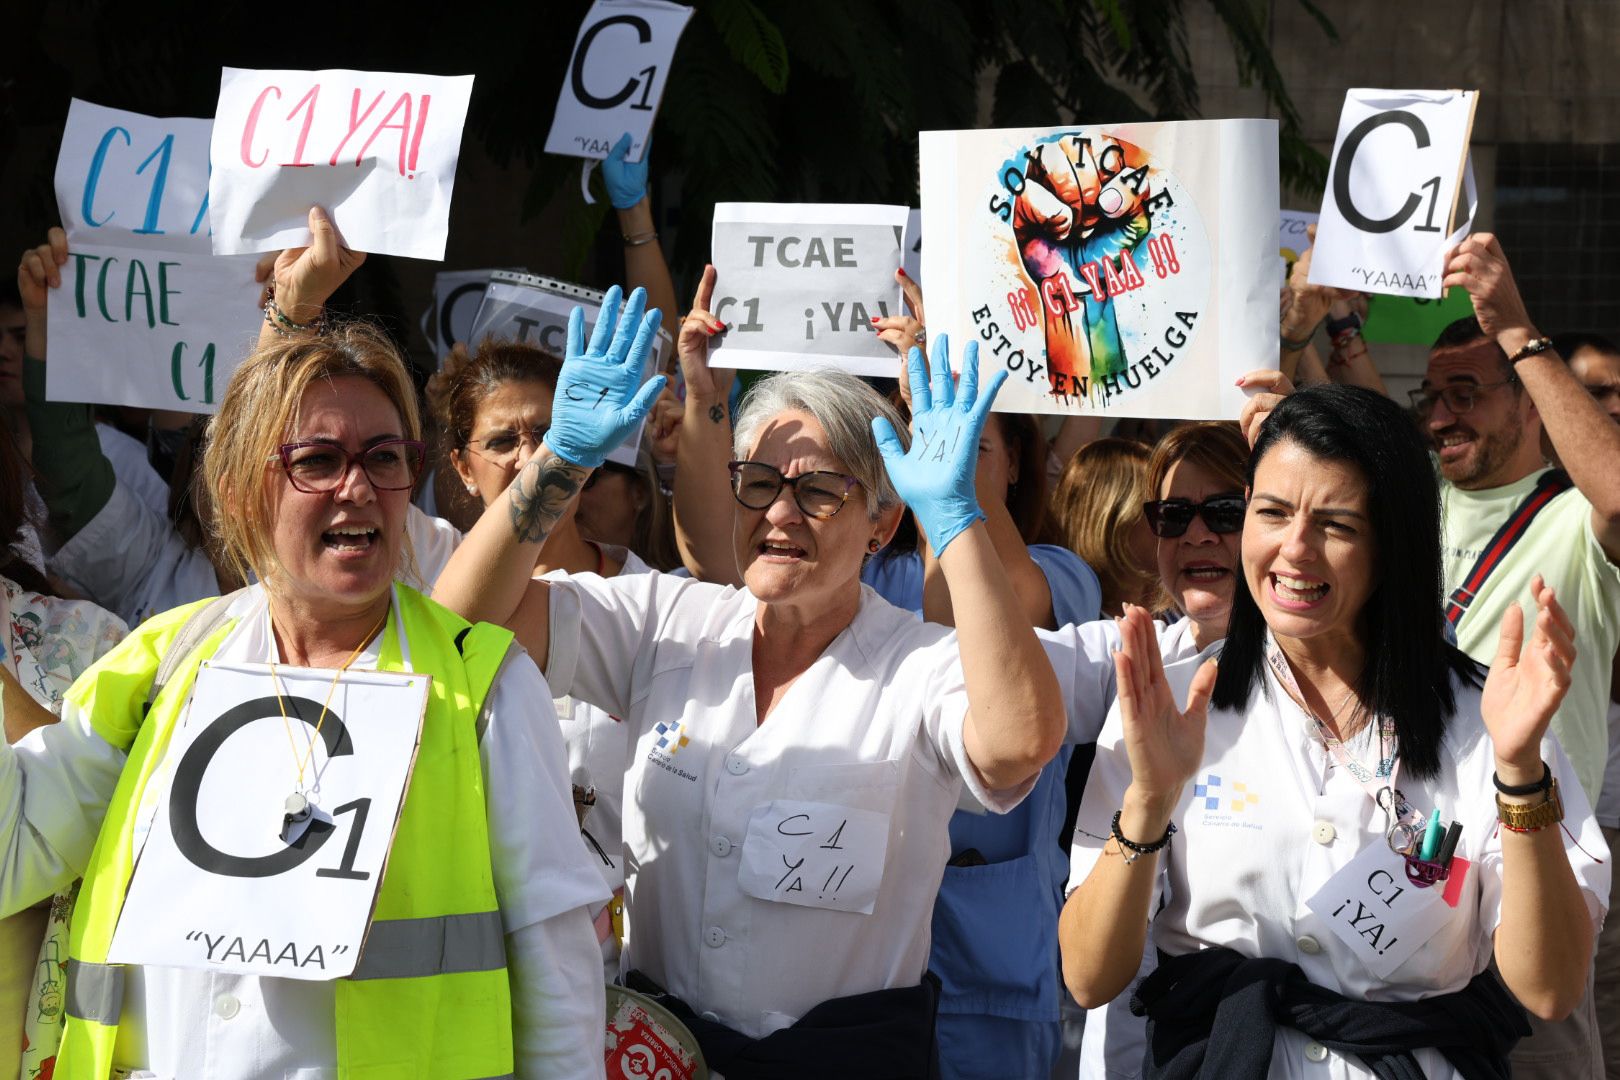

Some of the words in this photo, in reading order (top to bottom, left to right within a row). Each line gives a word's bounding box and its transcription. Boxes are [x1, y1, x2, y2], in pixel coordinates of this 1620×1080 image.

[571, 14, 657, 112] C1
[240, 84, 321, 169] C1
[329, 87, 432, 180] YA!
[81, 126, 175, 234] C1
[989, 145, 1044, 223] SOY
[1073, 137, 1174, 217] TCAE
[1333, 110, 1442, 234] C1
[748, 236, 858, 268] TCAE
[1041, 272, 1079, 317] C1
[1080, 249, 1144, 301] YAA
[1352, 267, 1438, 291] “YAAAA”
[68, 252, 182, 329] TCAE
[715, 297, 764, 332] C1
[171, 341, 216, 405] C1
[972, 303, 1043, 384] ESTOY
[1051, 375, 1089, 397] EN
[1103, 308, 1199, 397] HUELGA
[565, 382, 609, 410] C1
[919, 425, 962, 464] YA!
[169, 695, 372, 881] C1
[1367, 870, 1404, 909] C1
[185, 930, 349, 970] “YAAAA”
[1332, 899, 1398, 955] ¡YA!
[640, 1029, 663, 1053] OBRERA
